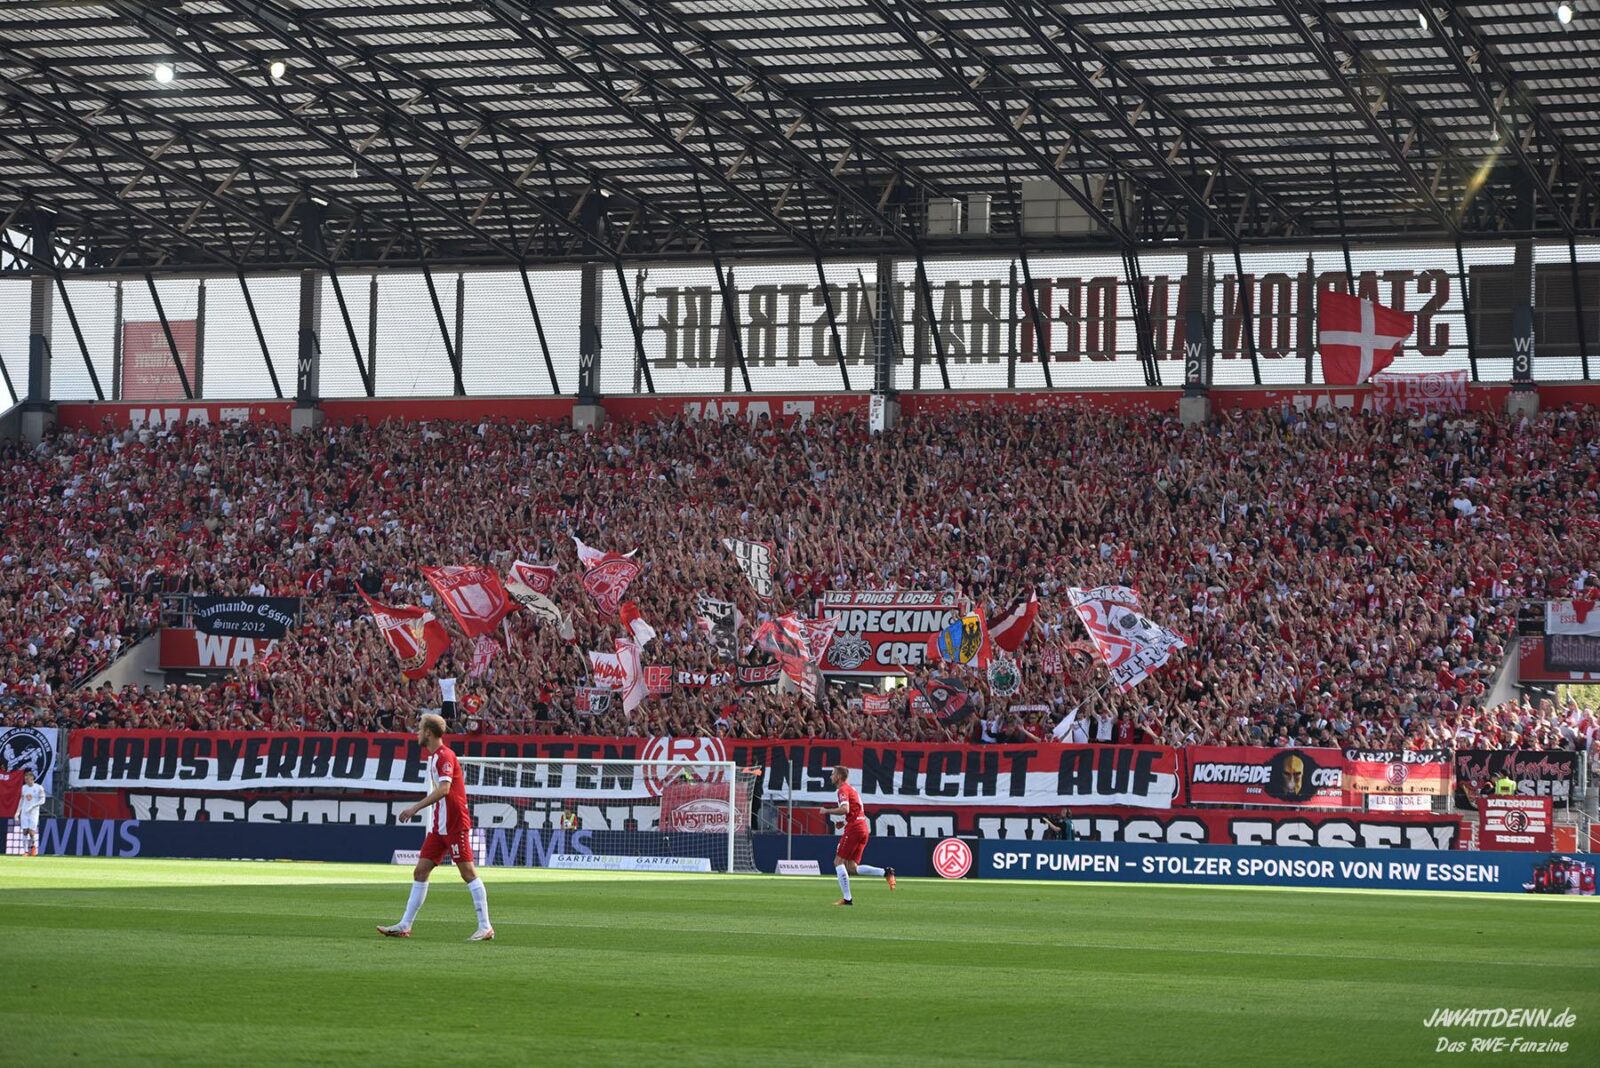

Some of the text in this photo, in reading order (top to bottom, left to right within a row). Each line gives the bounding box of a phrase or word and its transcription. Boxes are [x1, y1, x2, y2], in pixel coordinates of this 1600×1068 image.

[579, 354, 594, 387] W 1
[1185, 343, 1202, 377] W 2
[1513, 337, 1531, 373] W 3
[298, 358, 312, 391] W 1
[828, 592, 851, 604] LOS
[897, 592, 936, 604] LOCOS
[241, 621, 266, 632] 2012
[79, 736, 428, 783] HAUSVERBOTE
[862, 749, 1037, 797] NICHT
[1057, 748, 1163, 797] AUF
[1192, 763, 1272, 784] NORTHSIDE
[1458, 753, 1492, 781] Red
[1232, 821, 1454, 850] ESSEN
[992, 852, 1031, 870] SPT
[1036, 853, 1119, 872] PUMPEN
[1141, 856, 1231, 875] STOLZER
[1237, 859, 1334, 878] SPONSOR
[1340, 862, 1382, 880] VON
[1389, 864, 1421, 880] RW
[1426, 864, 1500, 883] ESSEN!
